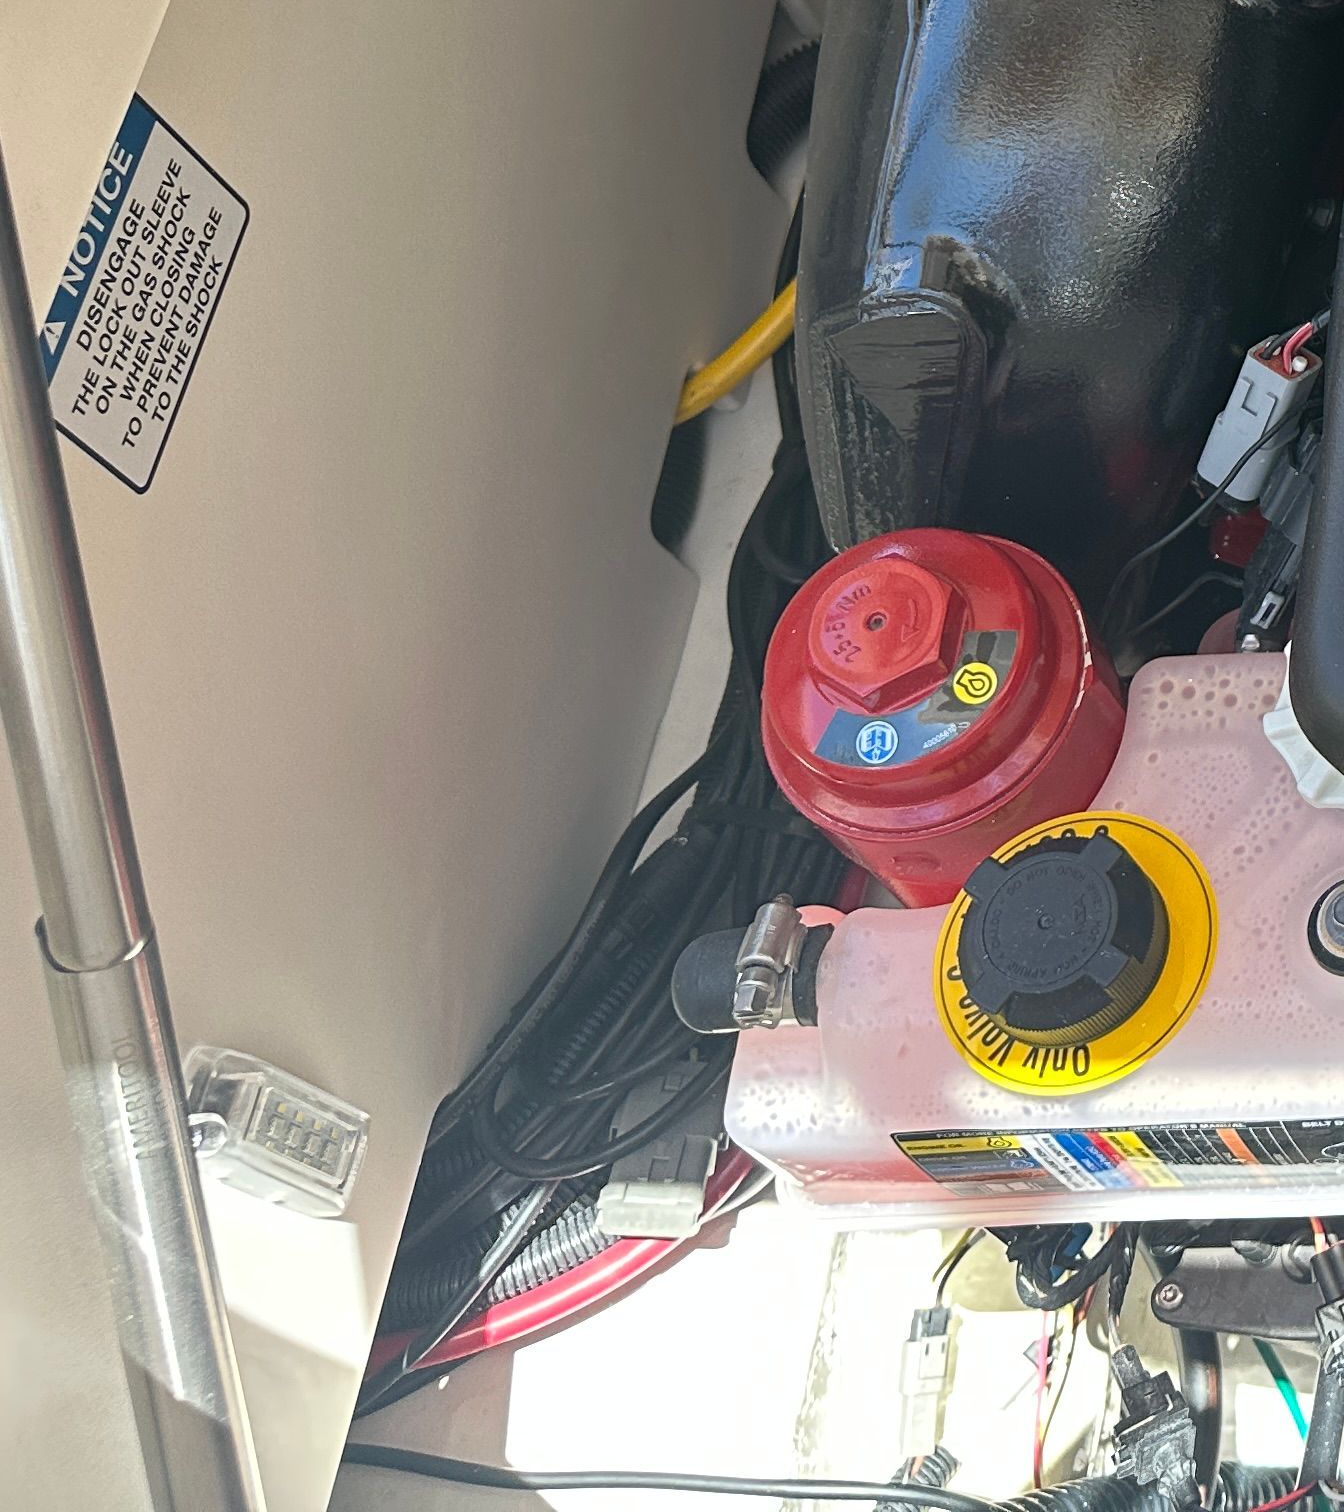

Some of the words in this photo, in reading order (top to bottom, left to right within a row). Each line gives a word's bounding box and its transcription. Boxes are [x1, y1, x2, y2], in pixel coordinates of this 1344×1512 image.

[59, 141, 133, 297] NOTICE
[71, 367, 100, 416] THE
[93, 299, 126, 366] LOCK
[119, 244, 147, 297] OUT
[140, 157, 182, 245] SLEEVE
[76, 198, 145, 351] DISENGAGE
[93, 375, 118, 415] ON
[109, 324, 138, 371] THE
[128, 271, 159, 323] GAS
[150, 185, 191, 270] SHOCK
[118, 330, 156, 400] WHEN
[148, 225, 196, 328] CLOSING
[121, 415, 143, 448] TO
[135, 304, 186, 413] PREVENT
[178, 206, 223, 304] DAMAGE
[151, 390, 173, 422] TO
[165, 339, 191, 385] THE
[183, 254, 223, 338] SHOCK
[111, 1028, 155, 1160] AMERITOOL
